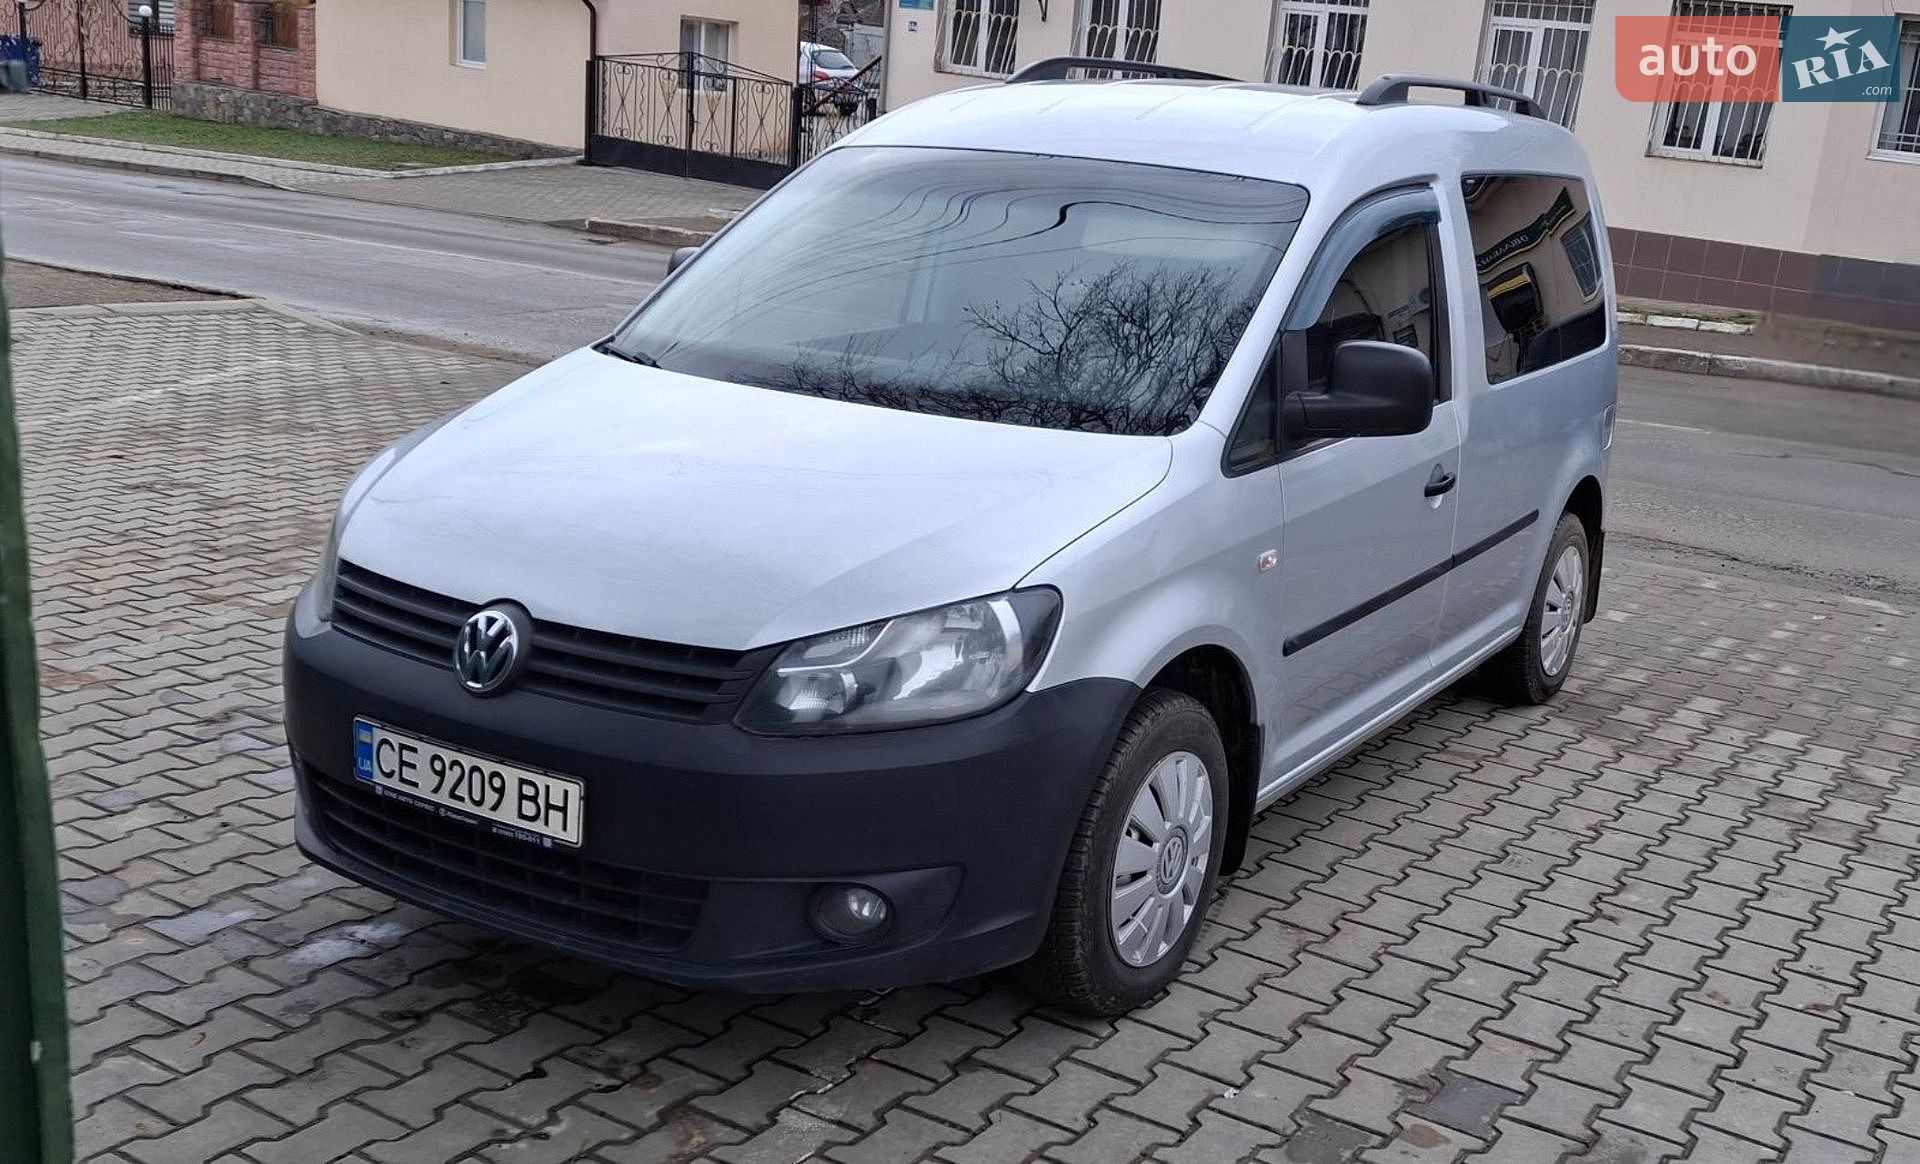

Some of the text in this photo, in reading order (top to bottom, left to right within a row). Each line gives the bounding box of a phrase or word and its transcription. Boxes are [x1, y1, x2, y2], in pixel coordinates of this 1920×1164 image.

[357, 757, 372, 773] UA
[376, 737, 568, 833] CE 9209 BH
